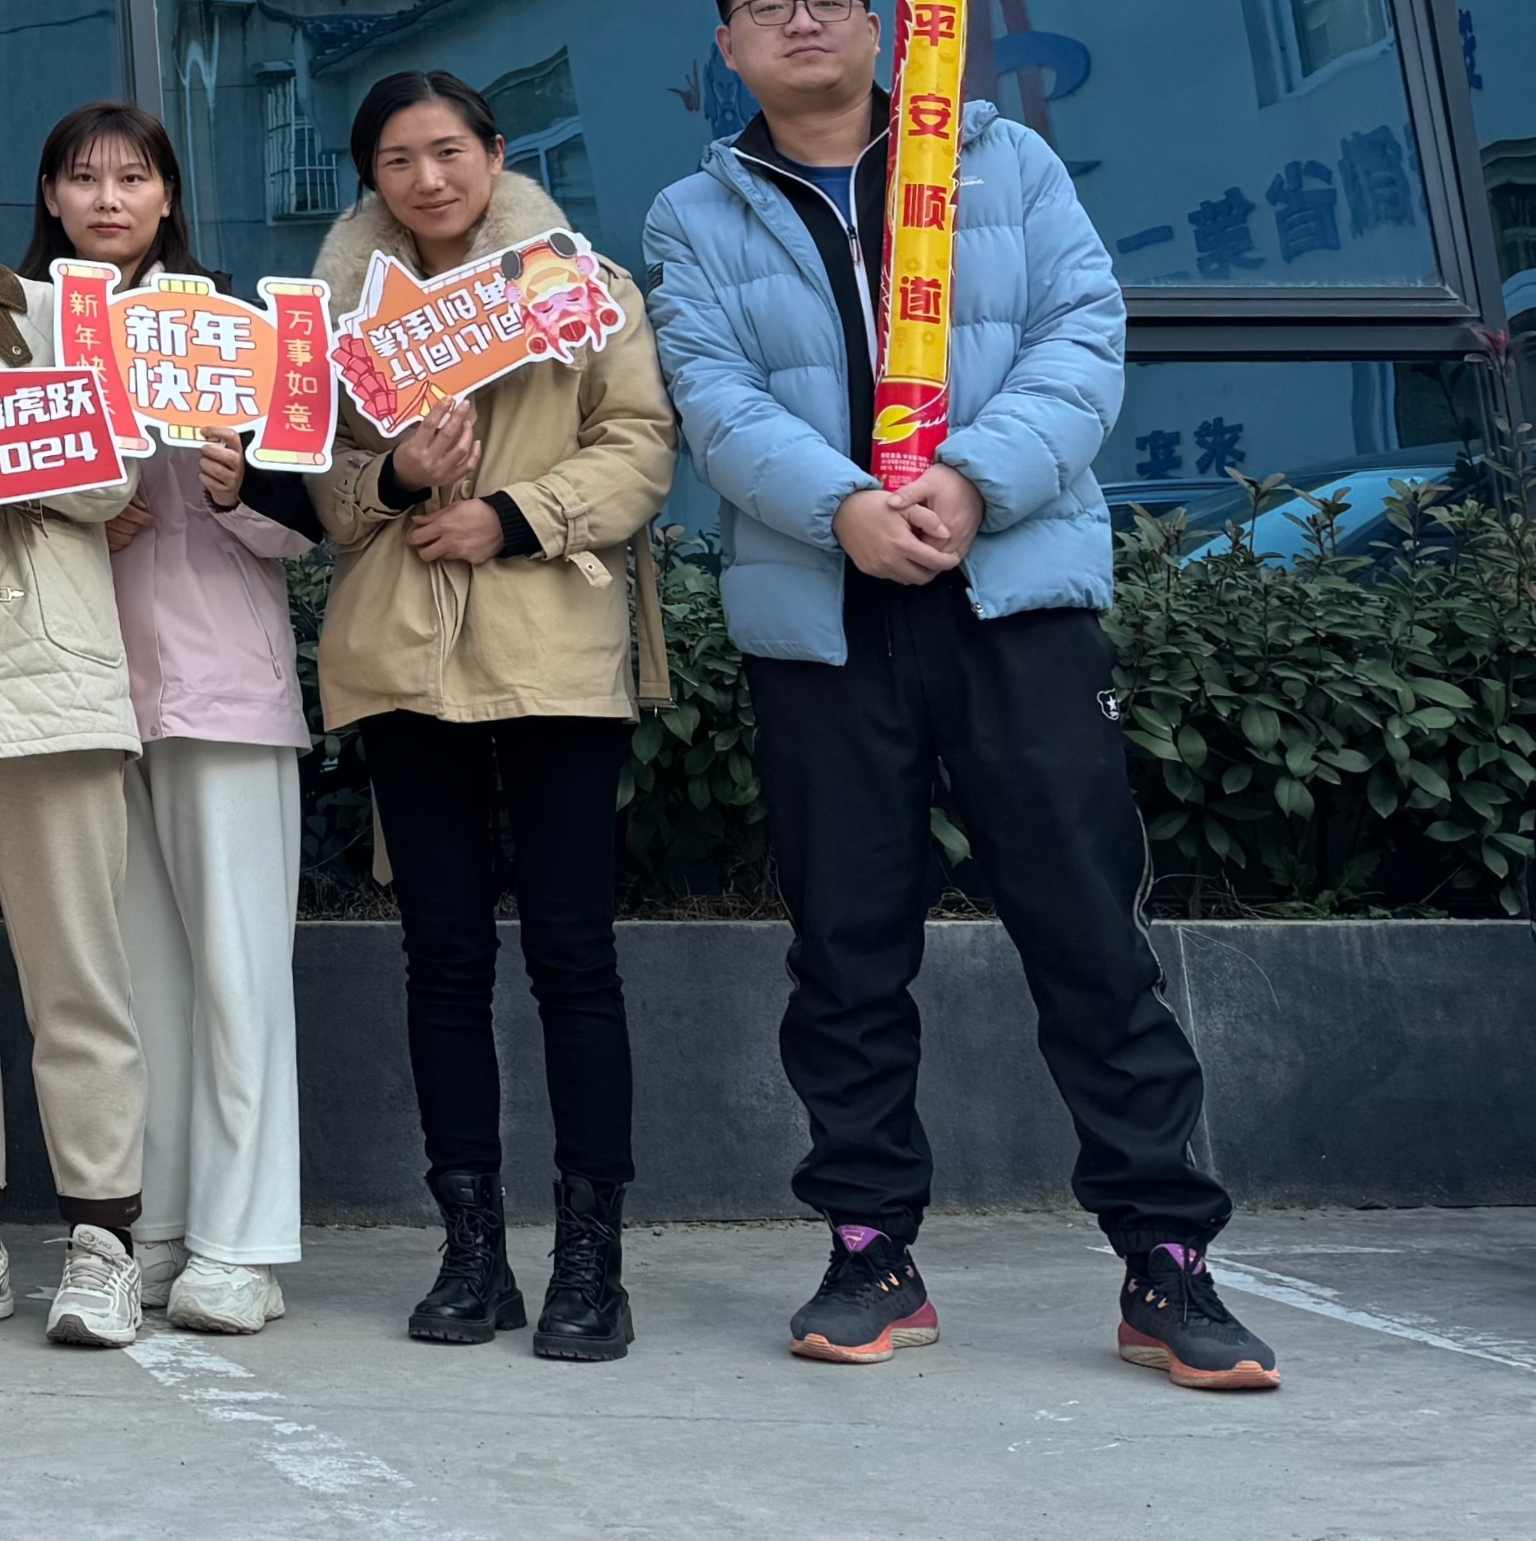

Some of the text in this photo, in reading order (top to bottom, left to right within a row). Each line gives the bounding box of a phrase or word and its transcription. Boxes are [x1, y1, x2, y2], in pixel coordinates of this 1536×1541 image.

[898, 3, 957, 325] 平安顺遂
[69, 290, 116, 415] 新年快
[124, 304, 257, 359] 新年
[368, 272, 507, 358] 再创佳绩
[389, 303, 526, 390] 同心同行
[128, 357, 259, 417] 快乐
[281, 309, 319, 433] 万事如意
